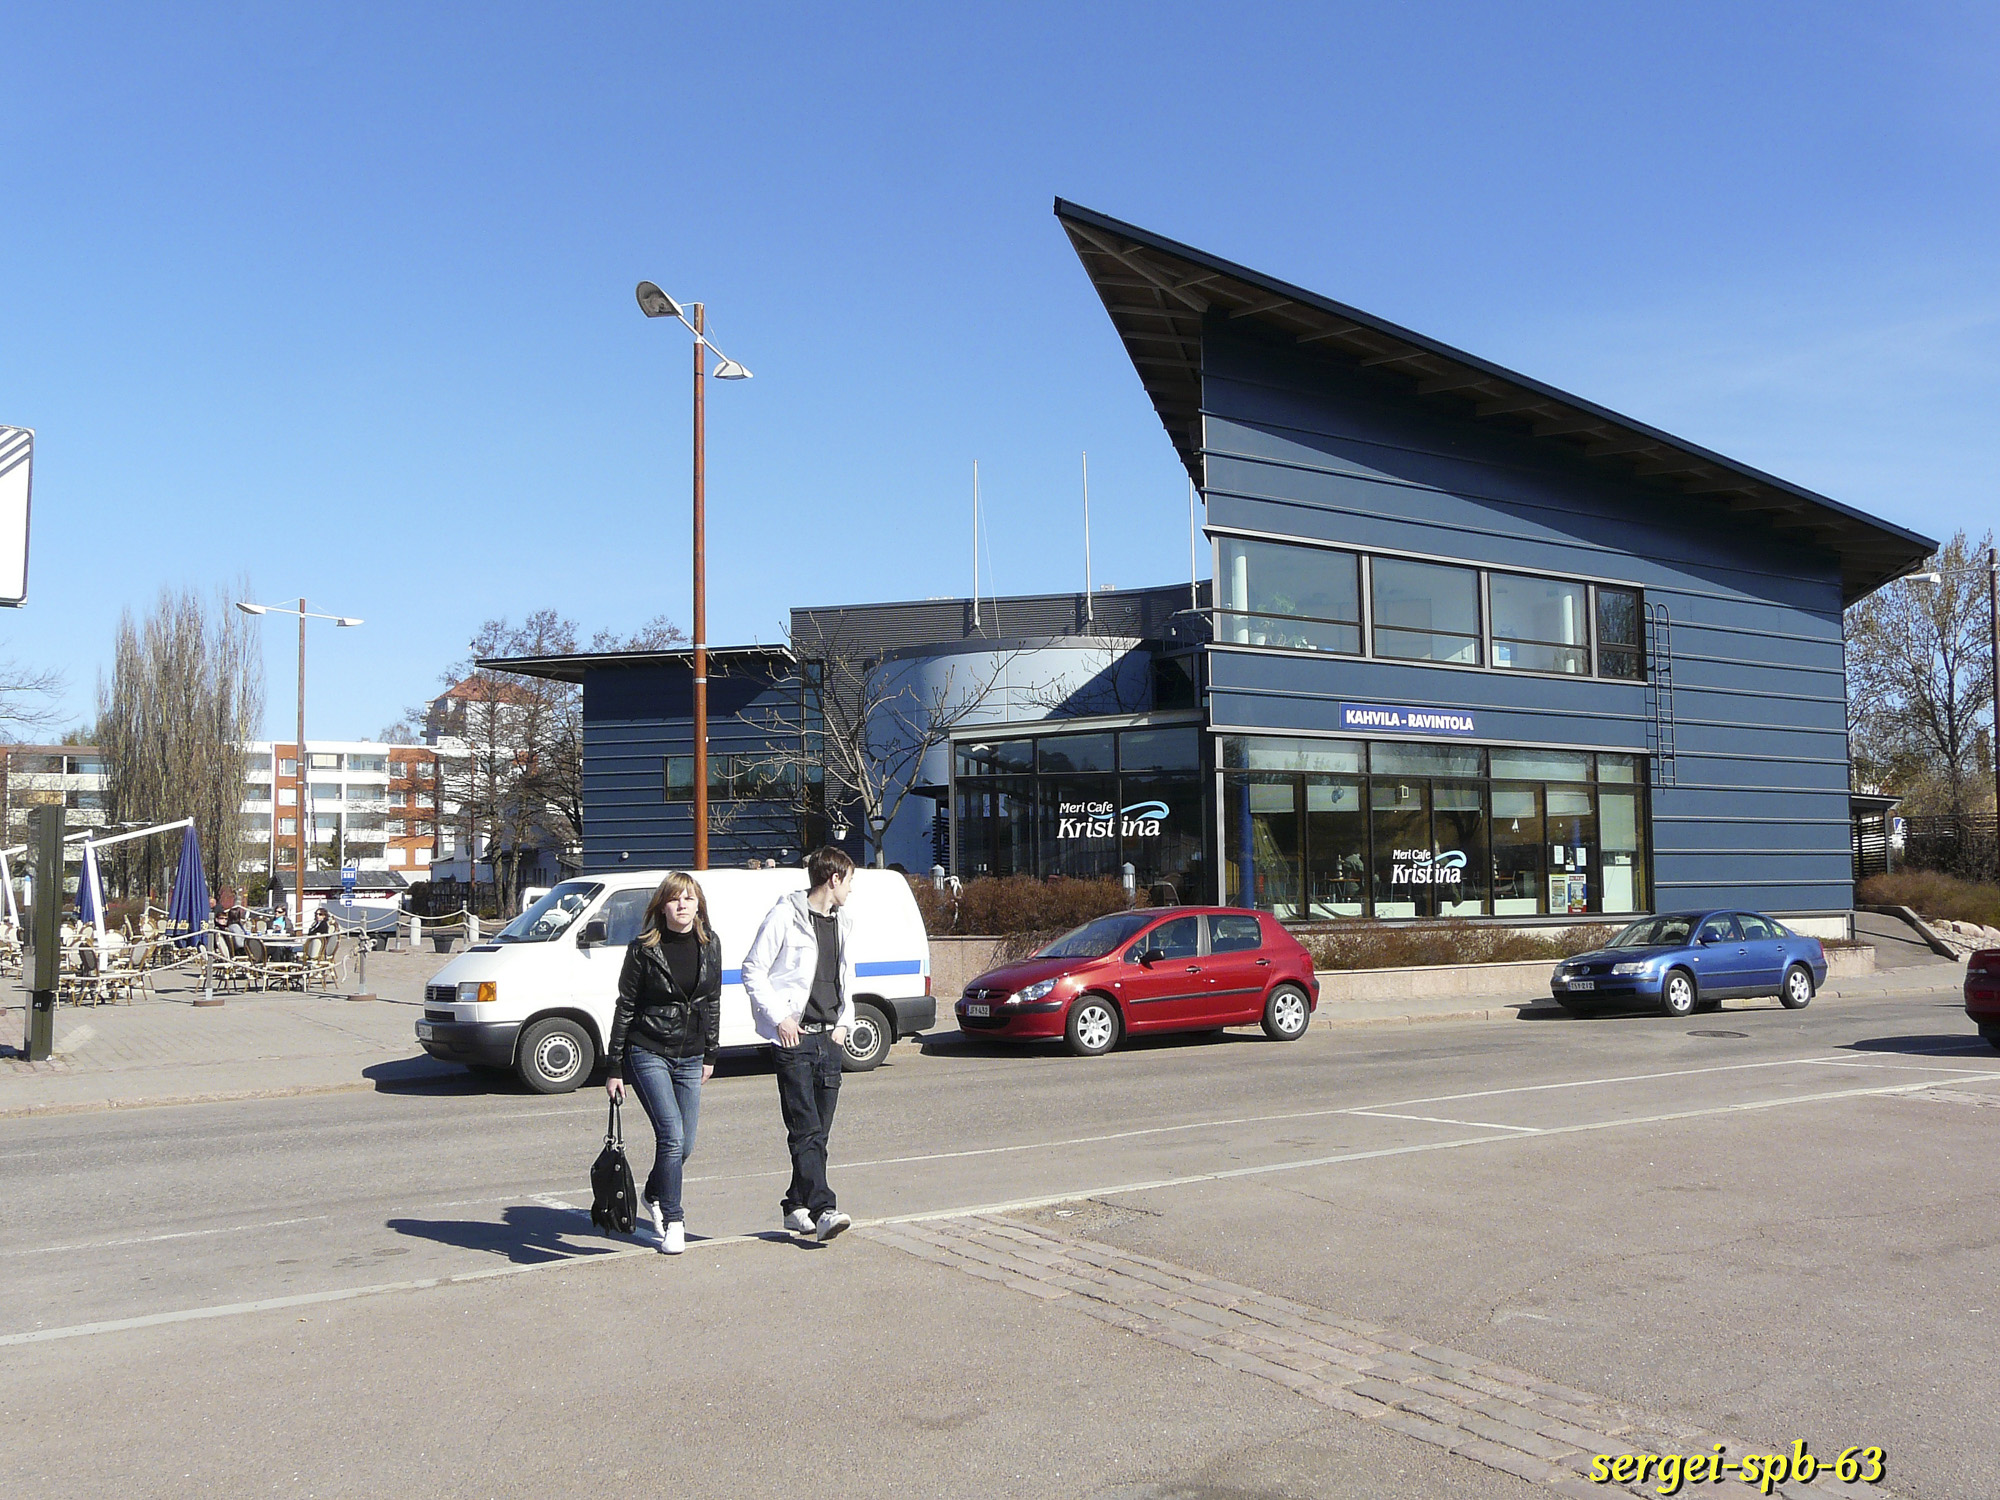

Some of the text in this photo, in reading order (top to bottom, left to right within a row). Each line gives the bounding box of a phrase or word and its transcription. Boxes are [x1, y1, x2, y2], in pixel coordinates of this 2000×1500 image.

[1060, 801, 1113, 814] Meri Cafe
[1393, 849, 1431, 861] Meri Cafe
